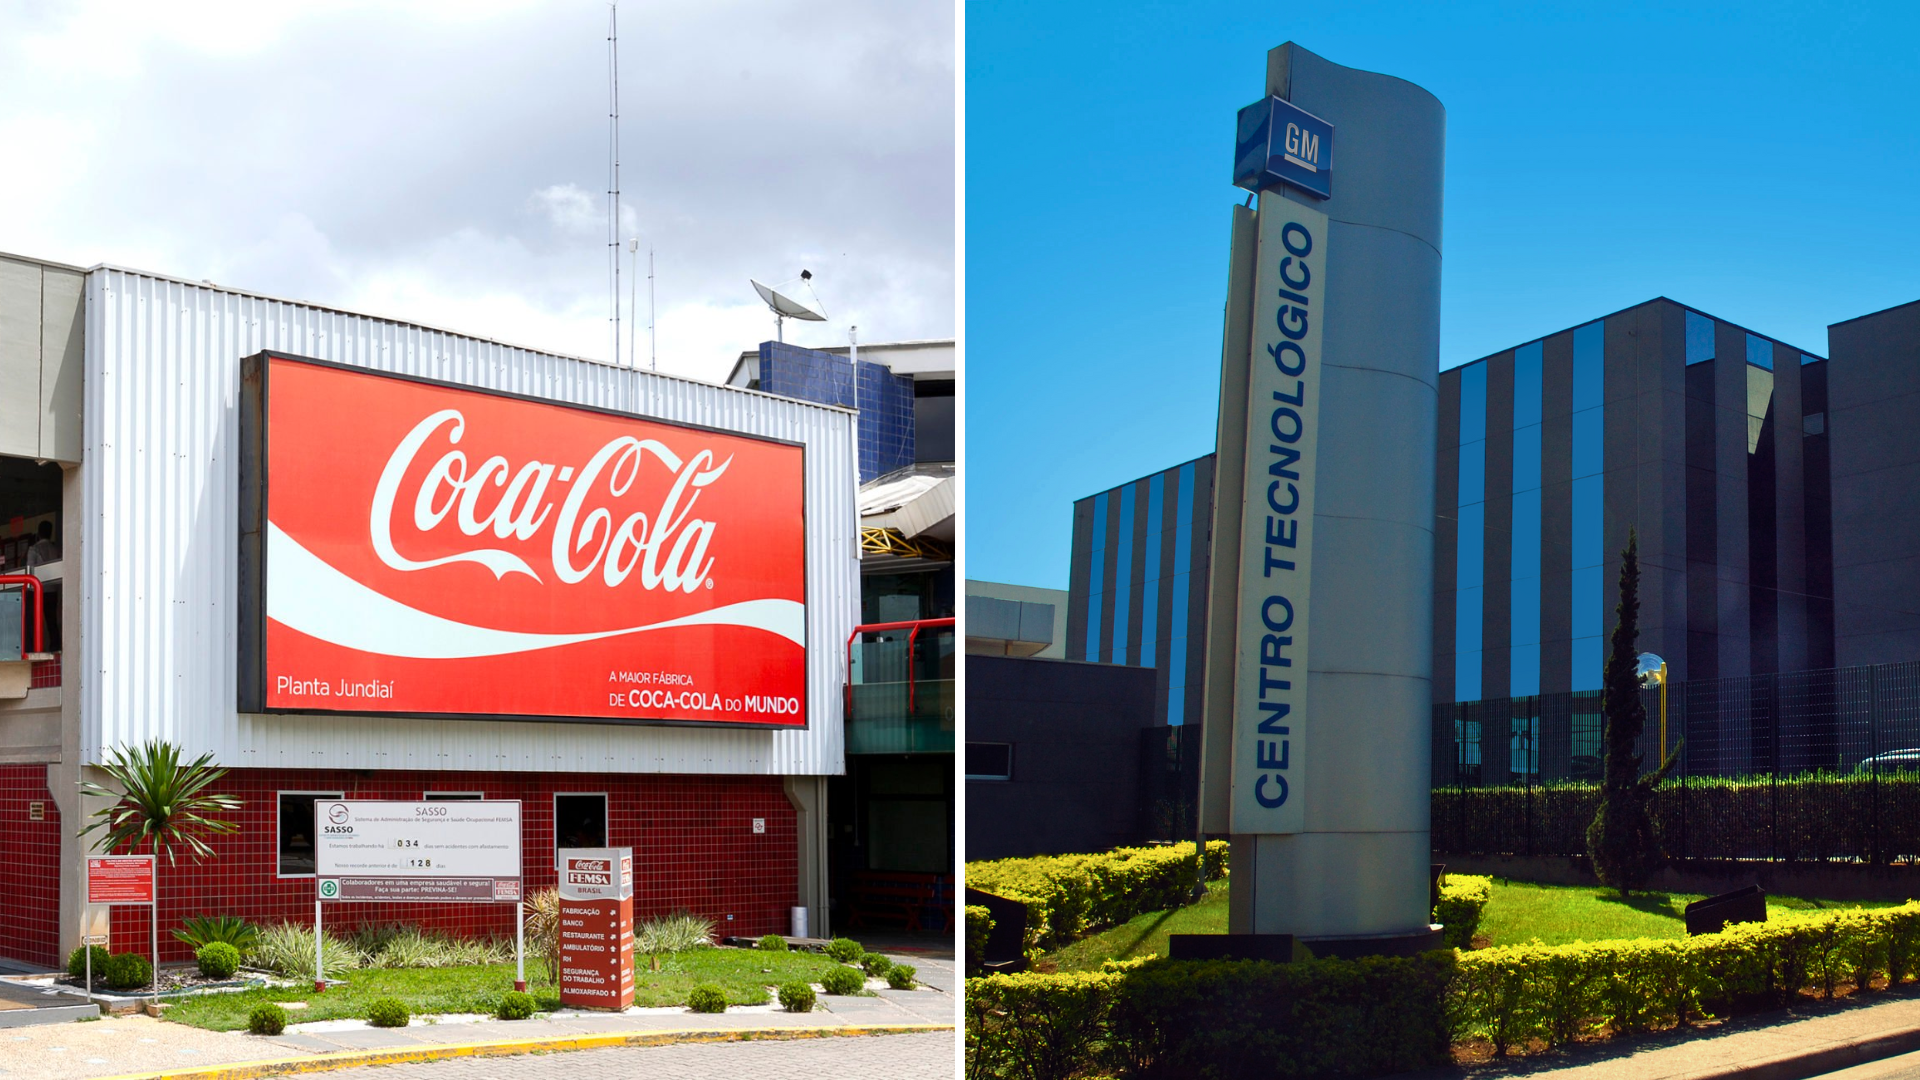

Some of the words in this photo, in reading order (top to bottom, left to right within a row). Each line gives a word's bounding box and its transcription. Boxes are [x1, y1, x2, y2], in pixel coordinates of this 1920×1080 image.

[1284, 122, 1319, 164] GM
[1264, 221, 1313, 578] TECNOLÓGICO
[370, 409, 734, 594] Coca-Cola
[608, 671, 617, 683] A
[619, 671, 650, 684] MAIOR
[652, 671, 694, 686] FÁBRICA
[277, 675, 330, 696] Planta
[335, 678, 394, 699] Jundiaí
[609, 693, 625, 707] DE
[628, 689, 723, 711] COCA-COLA
[725, 699, 742, 712] DO
[744, 695, 799, 715] MUNDO
[1255, 595, 1294, 809] CENTRO
[415, 807, 447, 816] SASSO
[575, 860, 605, 871] Coca-Cola
[569, 873, 609, 885] FEMSA
[562, 907, 601, 916] FABRICAÇÃO
[562, 919, 584, 927] BANCO
[562, 931, 605, 940] RESTAURANTE
[562, 943, 605, 952] AMBULATÓRIO
[562, 955, 572, 963] RH
[562, 967, 600, 977] SEGURANÇA
[573, 975, 605, 985] TRABALHO
[562, 987, 609, 997] ALMOXARIFADO
